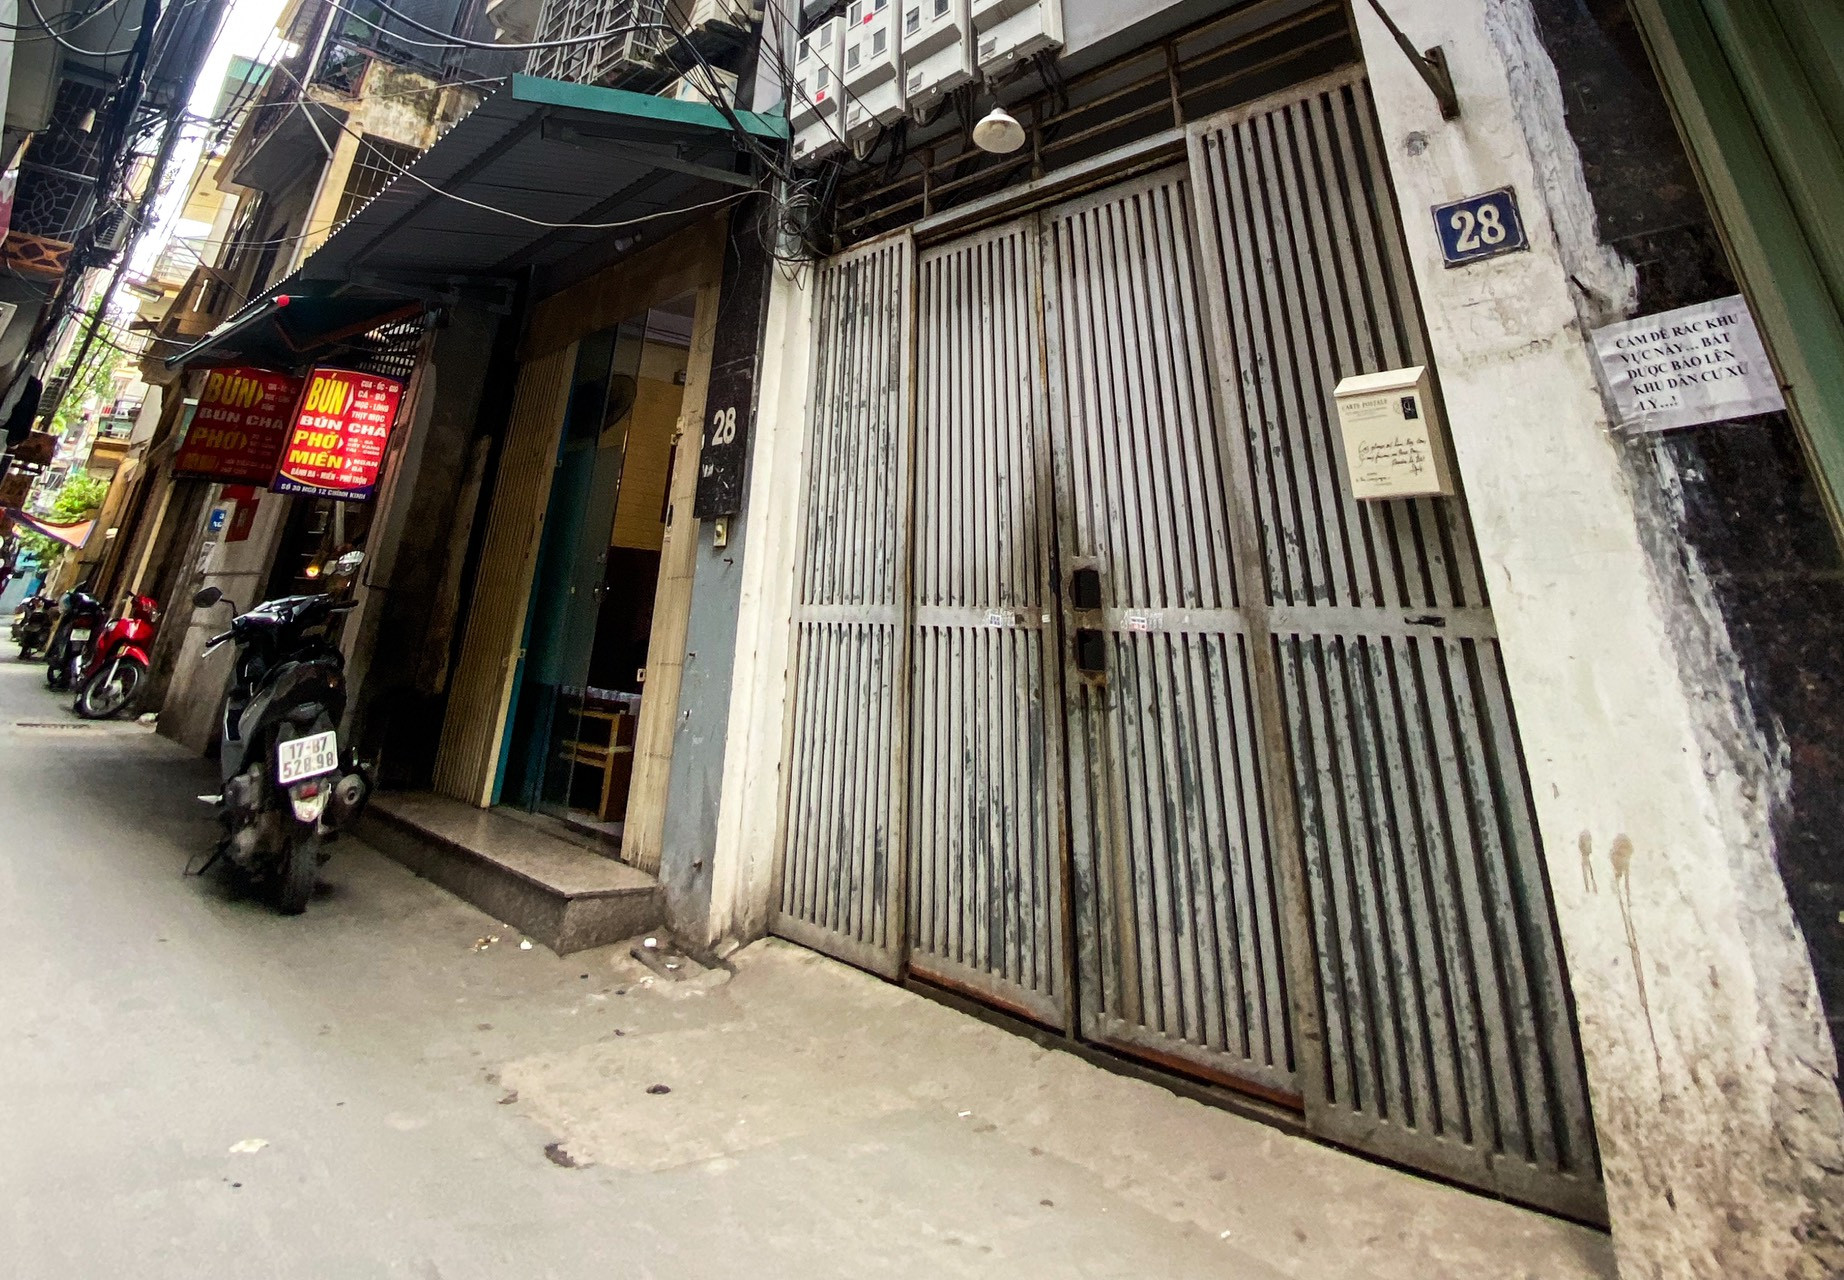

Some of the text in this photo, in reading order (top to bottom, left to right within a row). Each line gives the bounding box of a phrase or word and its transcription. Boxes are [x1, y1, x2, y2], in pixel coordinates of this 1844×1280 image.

[1450, 203, 1506, 252] 28
[1672, 322, 1701, 336] RÁC
[1706, 314, 1738, 329] KHU
[1621, 350, 1650, 364] VỰC
[1672, 356, 1701, 371] BÁO
[1704, 350, 1735, 364] LÊN
[204, 370, 258, 408] BÚN
[1633, 381, 1664, 394] KHU
[1667, 373, 1698, 388] DÂN
[1701, 367, 1721, 381] CƯ
[305, 373, 349, 415] BÚN
[300, 415, 386, 437] BÚN CHẢ
[712, 407, 736, 446] 28
[294, 429, 339, 449] PHỞ
[289, 450, 343, 469] MIẾN
